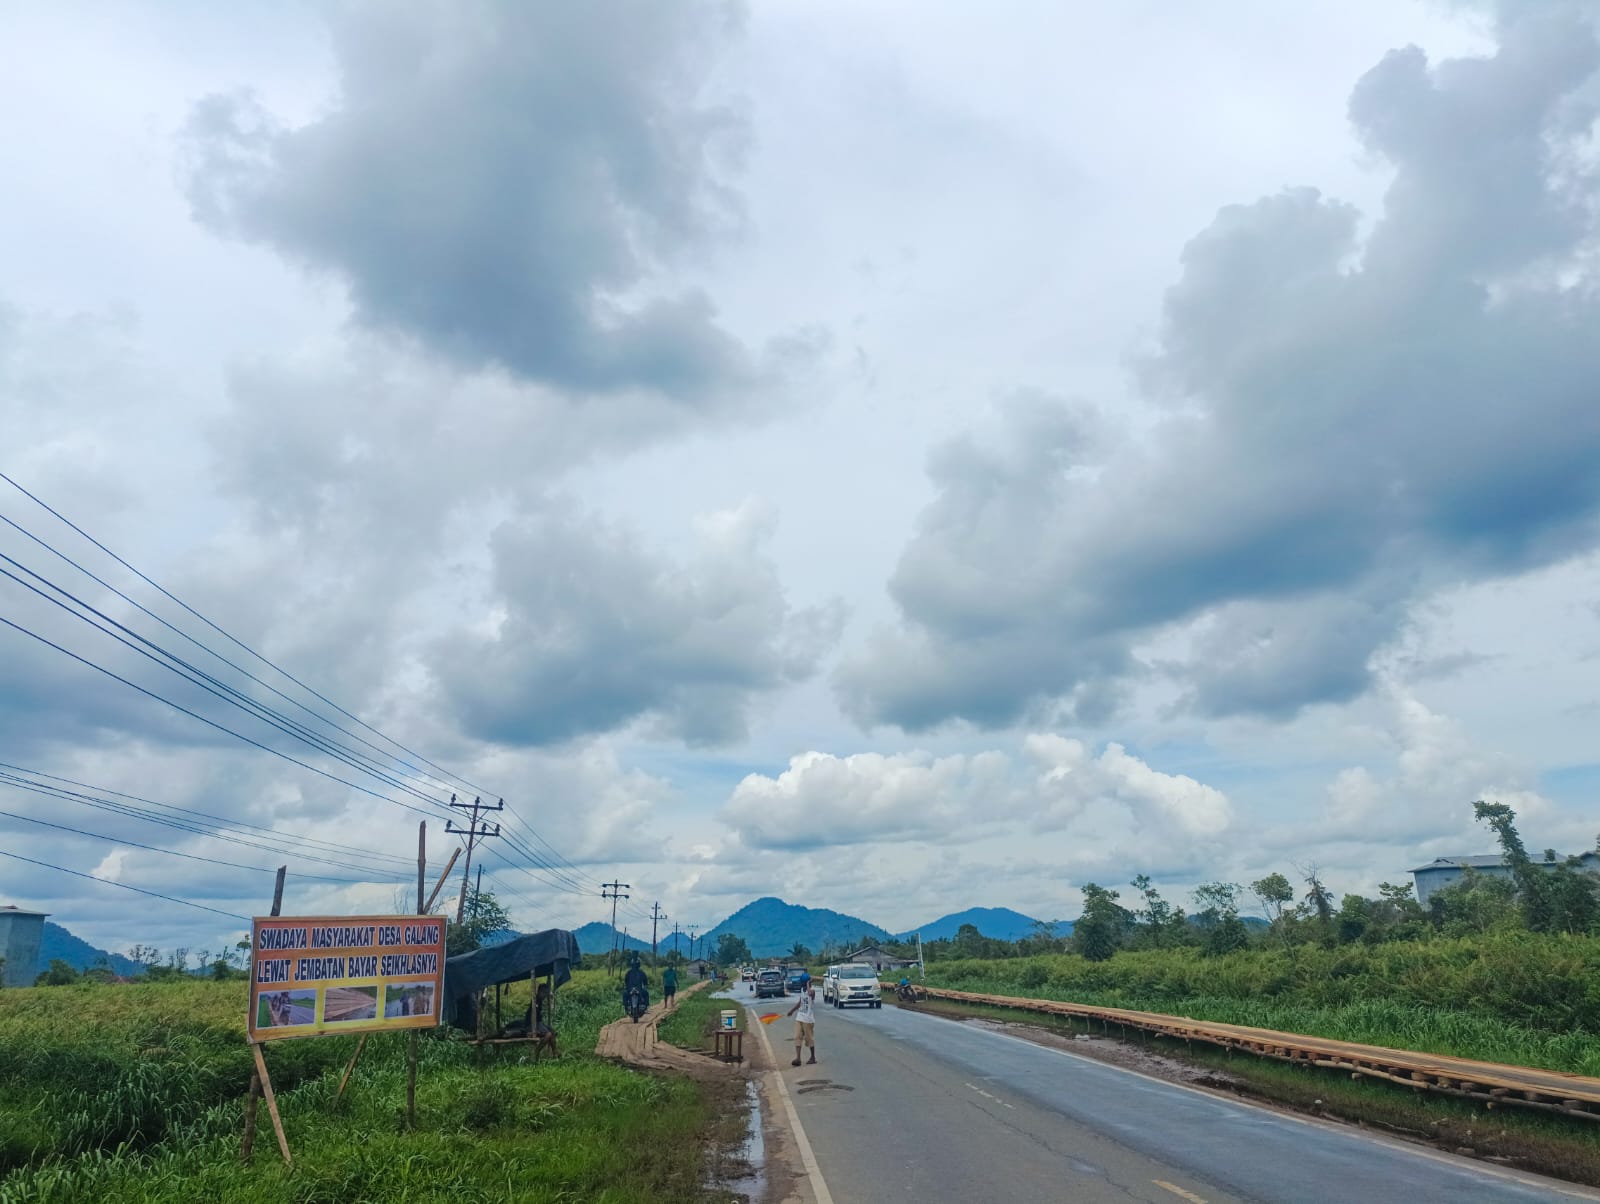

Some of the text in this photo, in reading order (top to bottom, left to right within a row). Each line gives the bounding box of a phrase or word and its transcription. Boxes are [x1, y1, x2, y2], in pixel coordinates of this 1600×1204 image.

[259, 924, 439, 949] SWADAYA MASYARAKAT DESA GALANG
[257, 952, 437, 983] LEWAT JEMBATAN BAYAR SEIKHLASNYA
